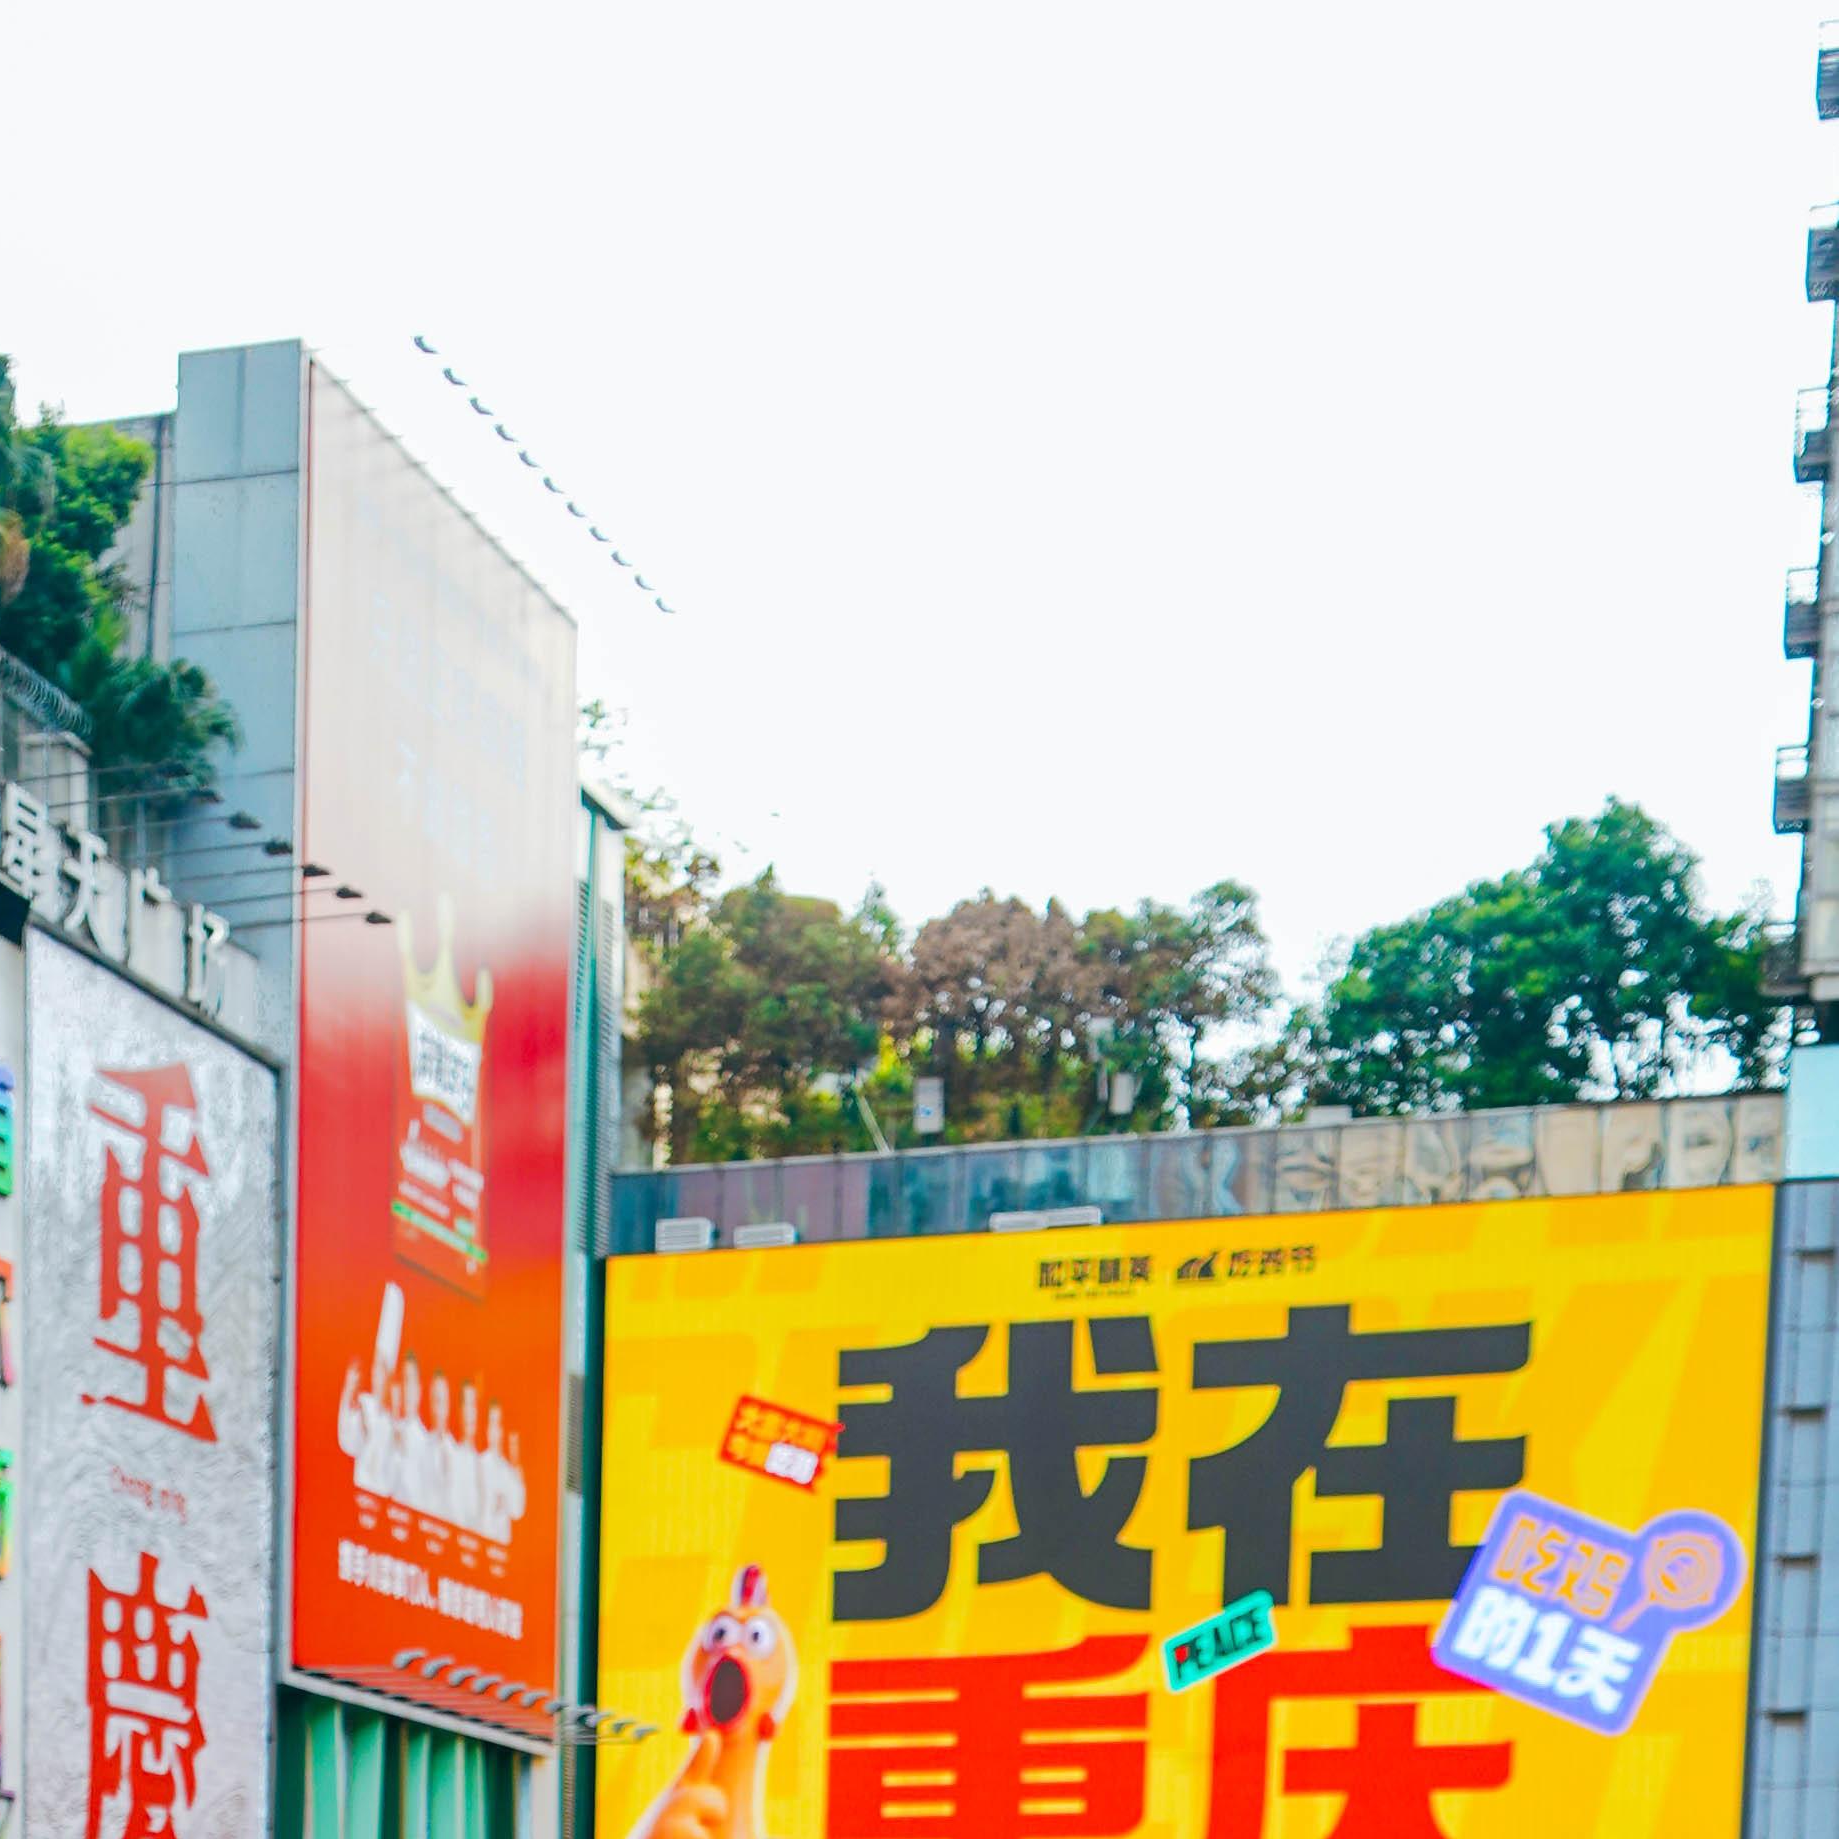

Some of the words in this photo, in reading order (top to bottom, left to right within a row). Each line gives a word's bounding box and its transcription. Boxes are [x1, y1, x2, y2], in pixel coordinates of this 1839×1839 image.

[833, 1303, 1532, 1622] 我在
[1488, 1517, 1635, 1621] 吃鸡
[1453, 1587, 1643, 1714] 的1天
